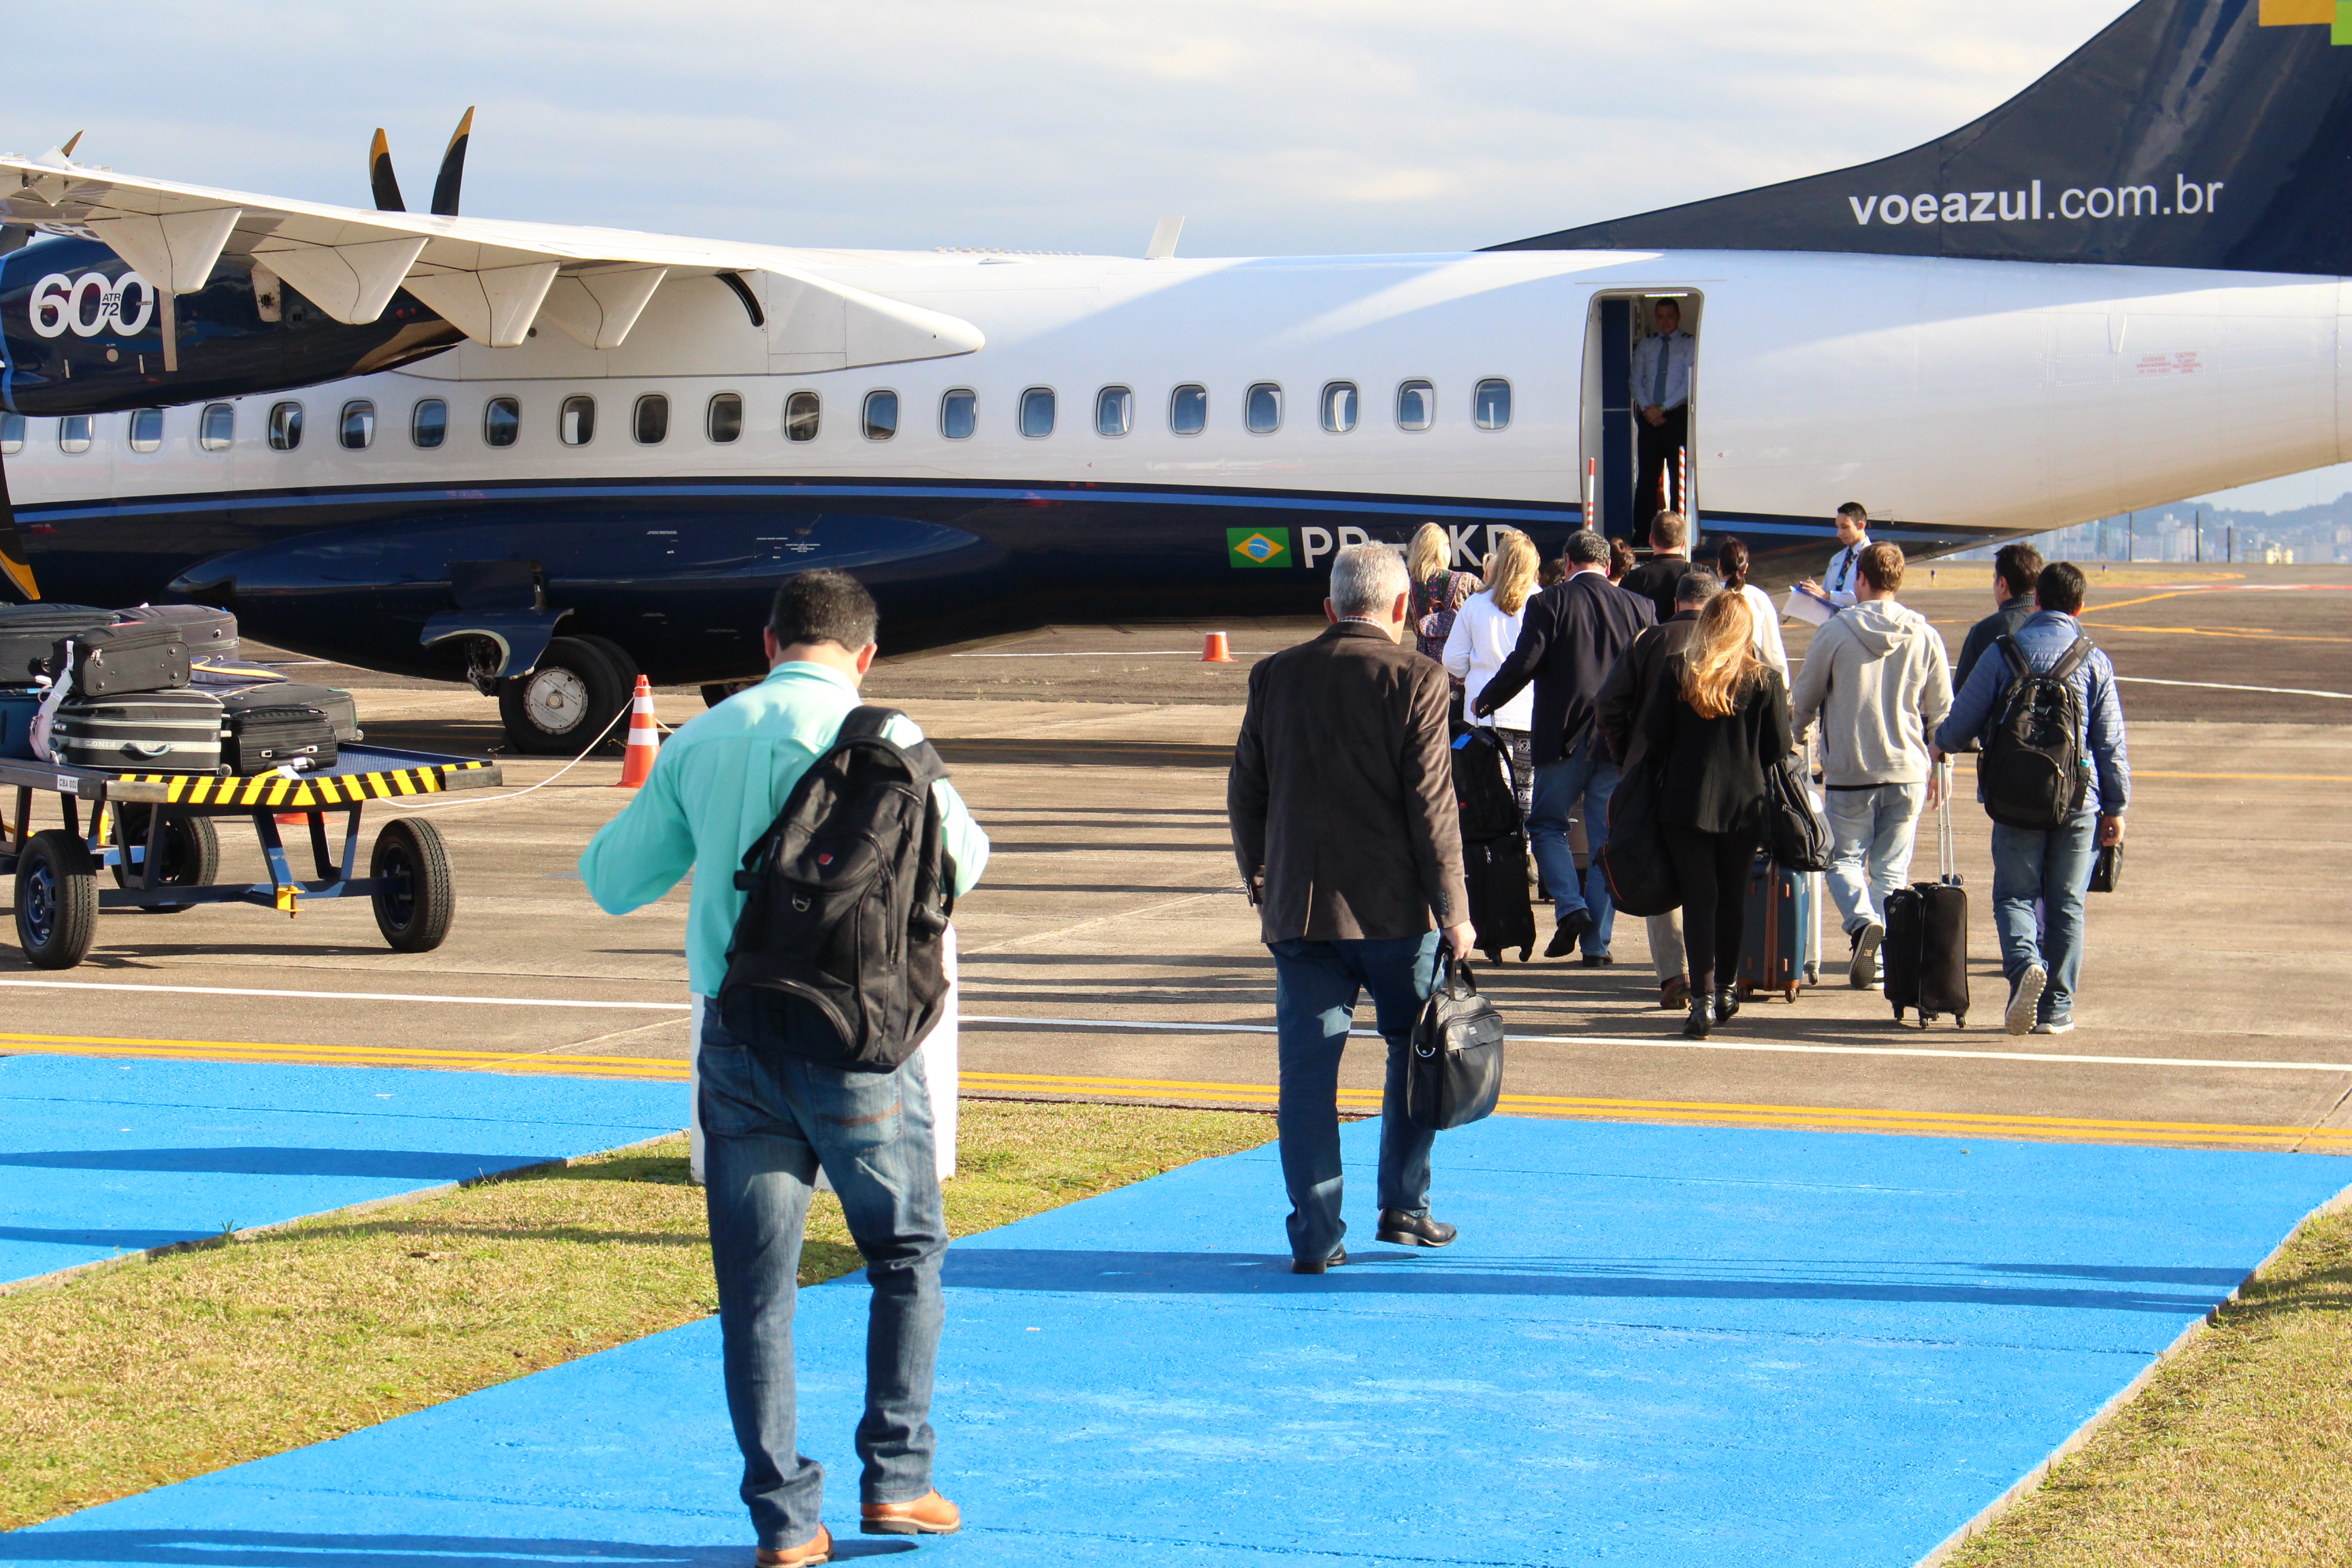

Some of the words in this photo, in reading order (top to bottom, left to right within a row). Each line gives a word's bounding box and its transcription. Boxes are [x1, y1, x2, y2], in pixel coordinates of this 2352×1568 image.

[1848, 174, 2224, 225] voeazul.com.br
[102, 293, 121, 301] ATR
[29, 271, 154, 338] 600
[101, 302, 119, 316] 72
[59, 779, 68, 787] CBA
